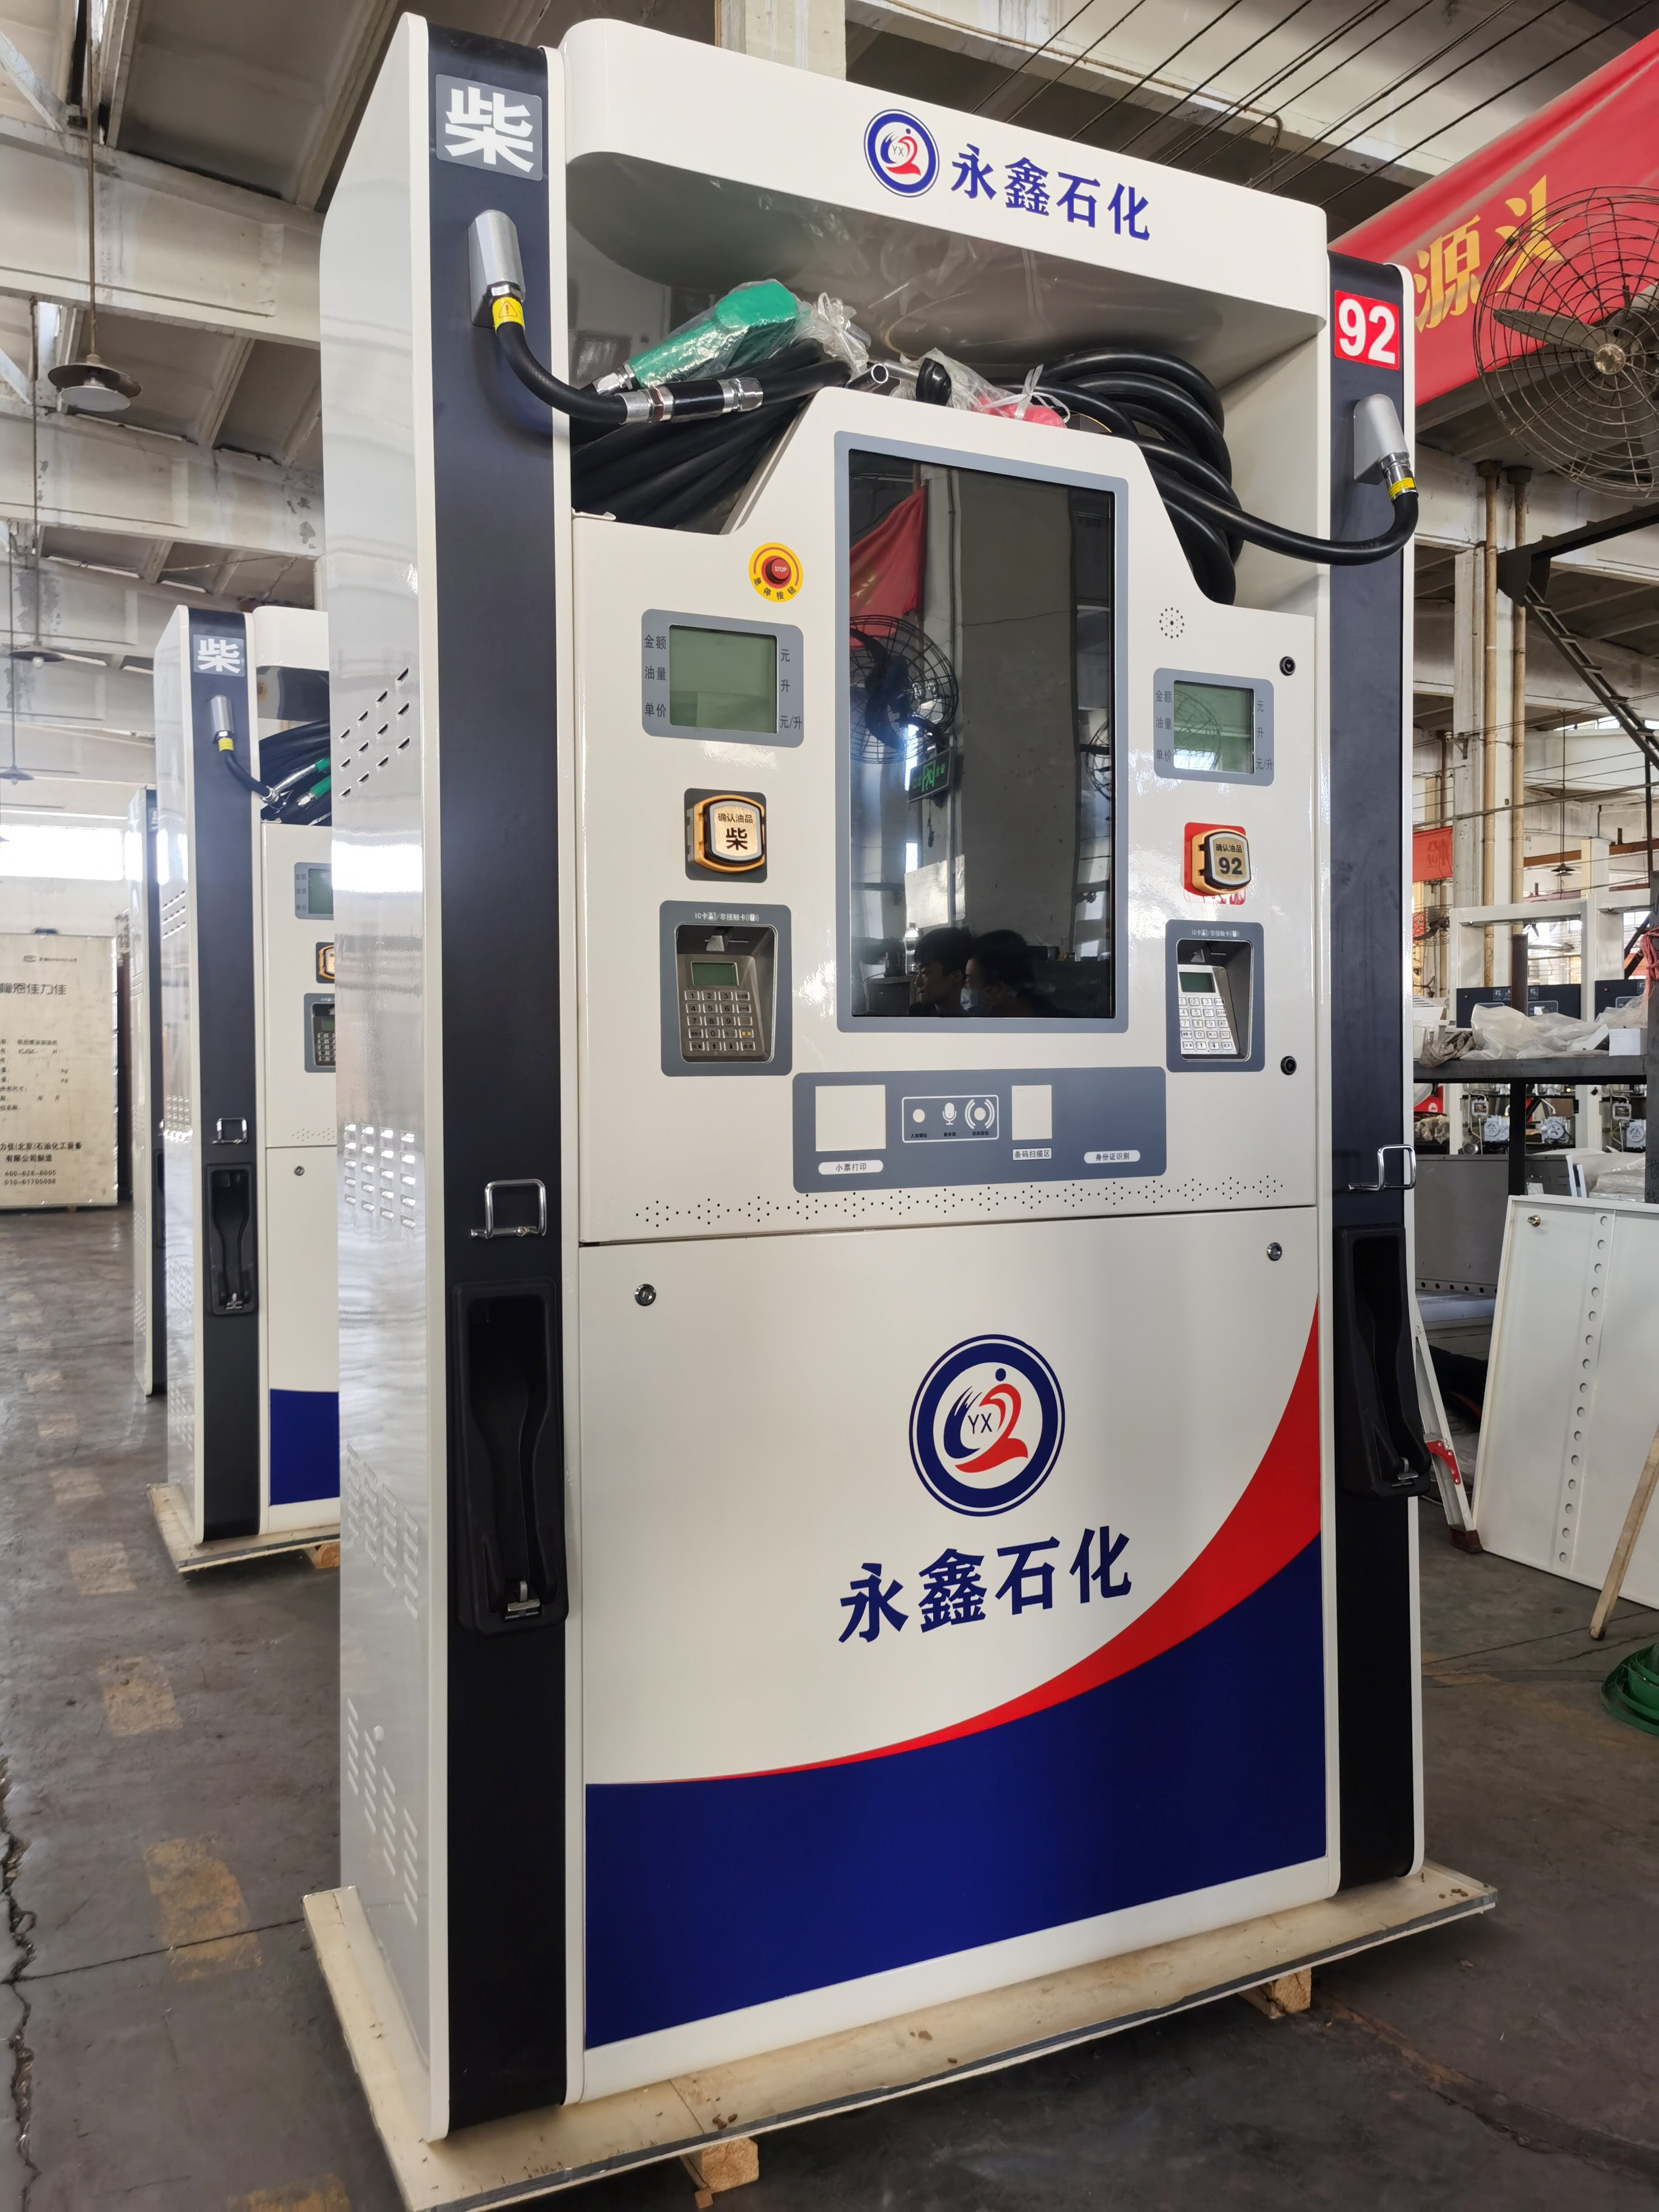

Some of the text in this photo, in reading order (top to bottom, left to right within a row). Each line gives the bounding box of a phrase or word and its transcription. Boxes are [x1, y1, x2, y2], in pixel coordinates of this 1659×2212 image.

[444, 87, 534, 173] 柴
[892, 144, 903, 156] YX
[951, 143, 1150, 241] 永鑫石化
[1413, 174, 1566, 333] 源头
[1338, 298, 1396, 364] 92
[644, 634, 666, 650] 金额
[198, 638, 241, 674] 柴
[780, 649, 790, 662] 元
[645, 665, 666, 681] 油量
[780, 679, 790, 692] 升
[1155, 689, 1172, 703] 金额
[645, 703, 666, 719] 单价
[1256, 700, 1264, 712] 元
[780, 715, 802, 729] 元/升
[1156, 717, 1171, 730] 油量
[1256, 727, 1264, 739] 升
[1156, 748, 1172, 762] 单价
[1256, 758, 1273, 770] 元/升
[718, 813, 753, 823] 确认油品
[726, 828, 748, 850] 柴
[1216, 843, 1242, 853] 确认油品
[1219, 856, 1243, 875] 92
[6, 1153, 53, 1162] 有限公司制造
[1014, 1150, 1050, 1159] 条码扫描区
[1095, 1152, 1130, 1161] 身份证识别
[836, 1163, 866, 1171] 小票打印
[968, 1413, 992, 1434] YX
[839, 1526, 1132, 1644] 永鑫石化
